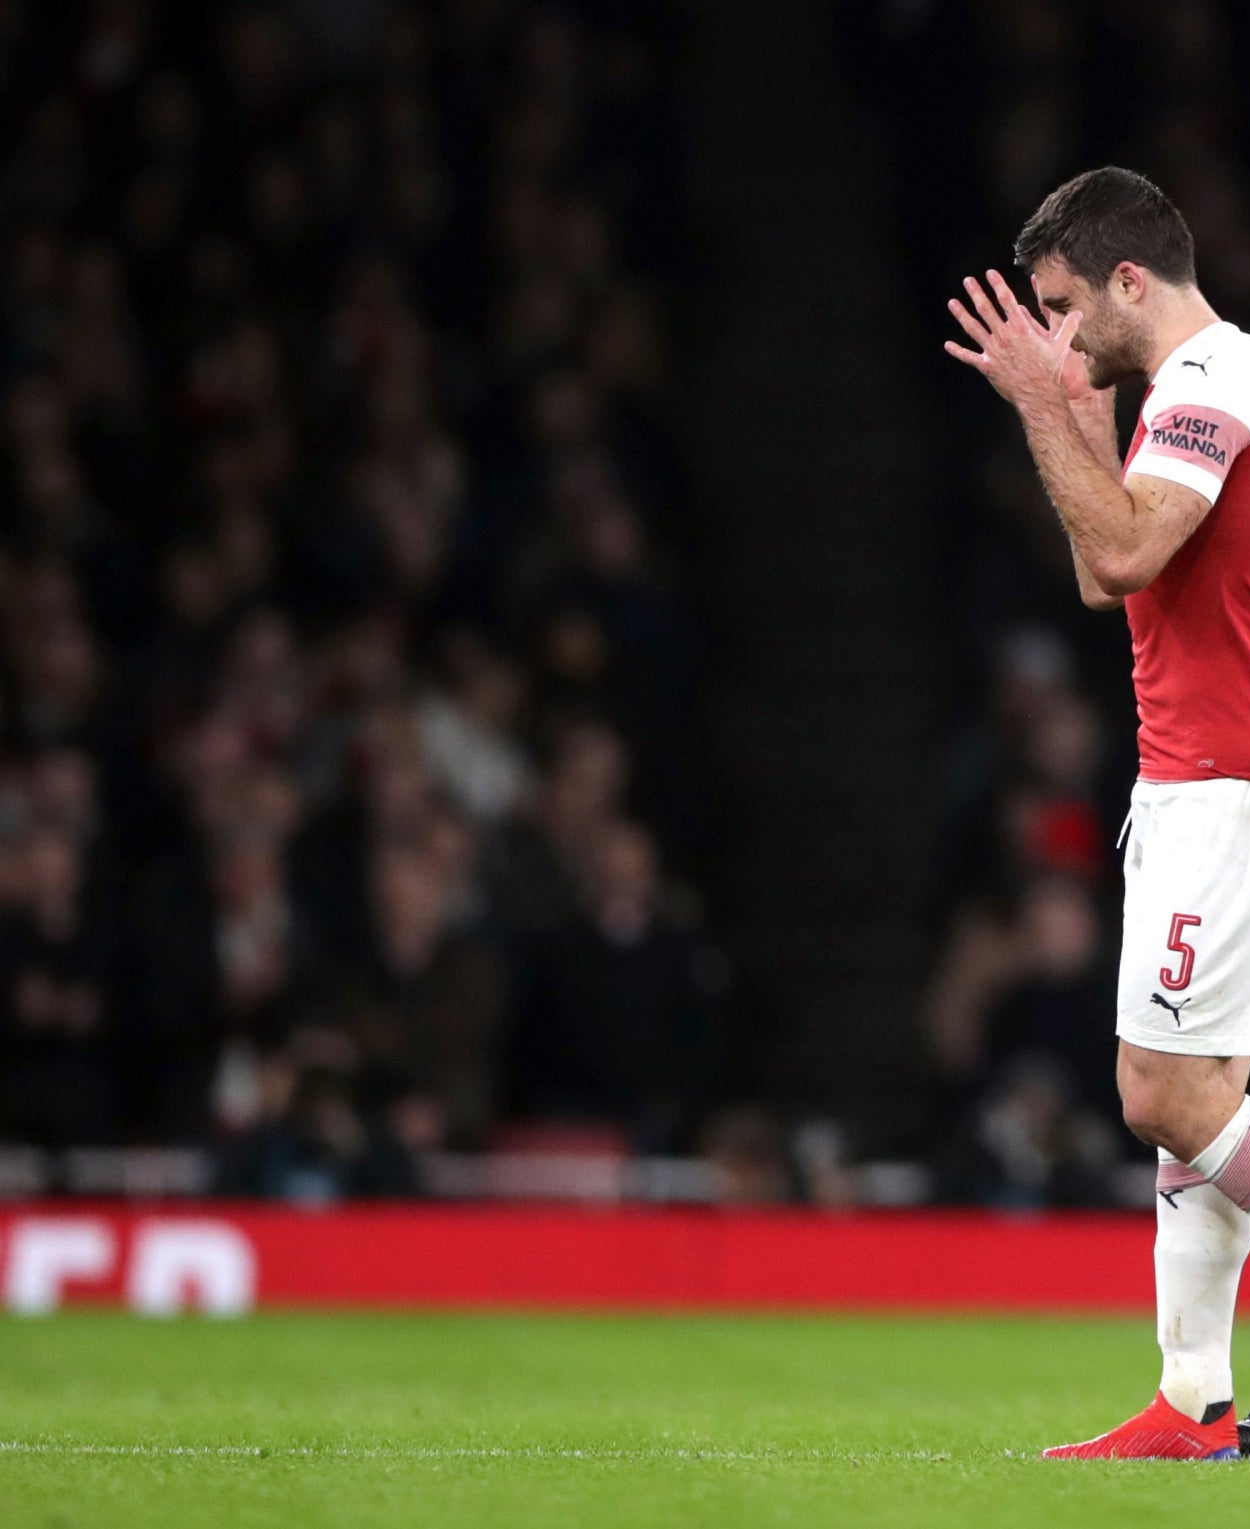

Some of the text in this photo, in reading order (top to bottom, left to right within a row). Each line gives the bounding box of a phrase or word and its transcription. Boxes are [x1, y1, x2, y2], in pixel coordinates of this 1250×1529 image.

[1172, 415, 1219, 439] VISIT
[1151, 429, 1227, 467] RWANDA
[1159, 912, 1202, 991] 5
